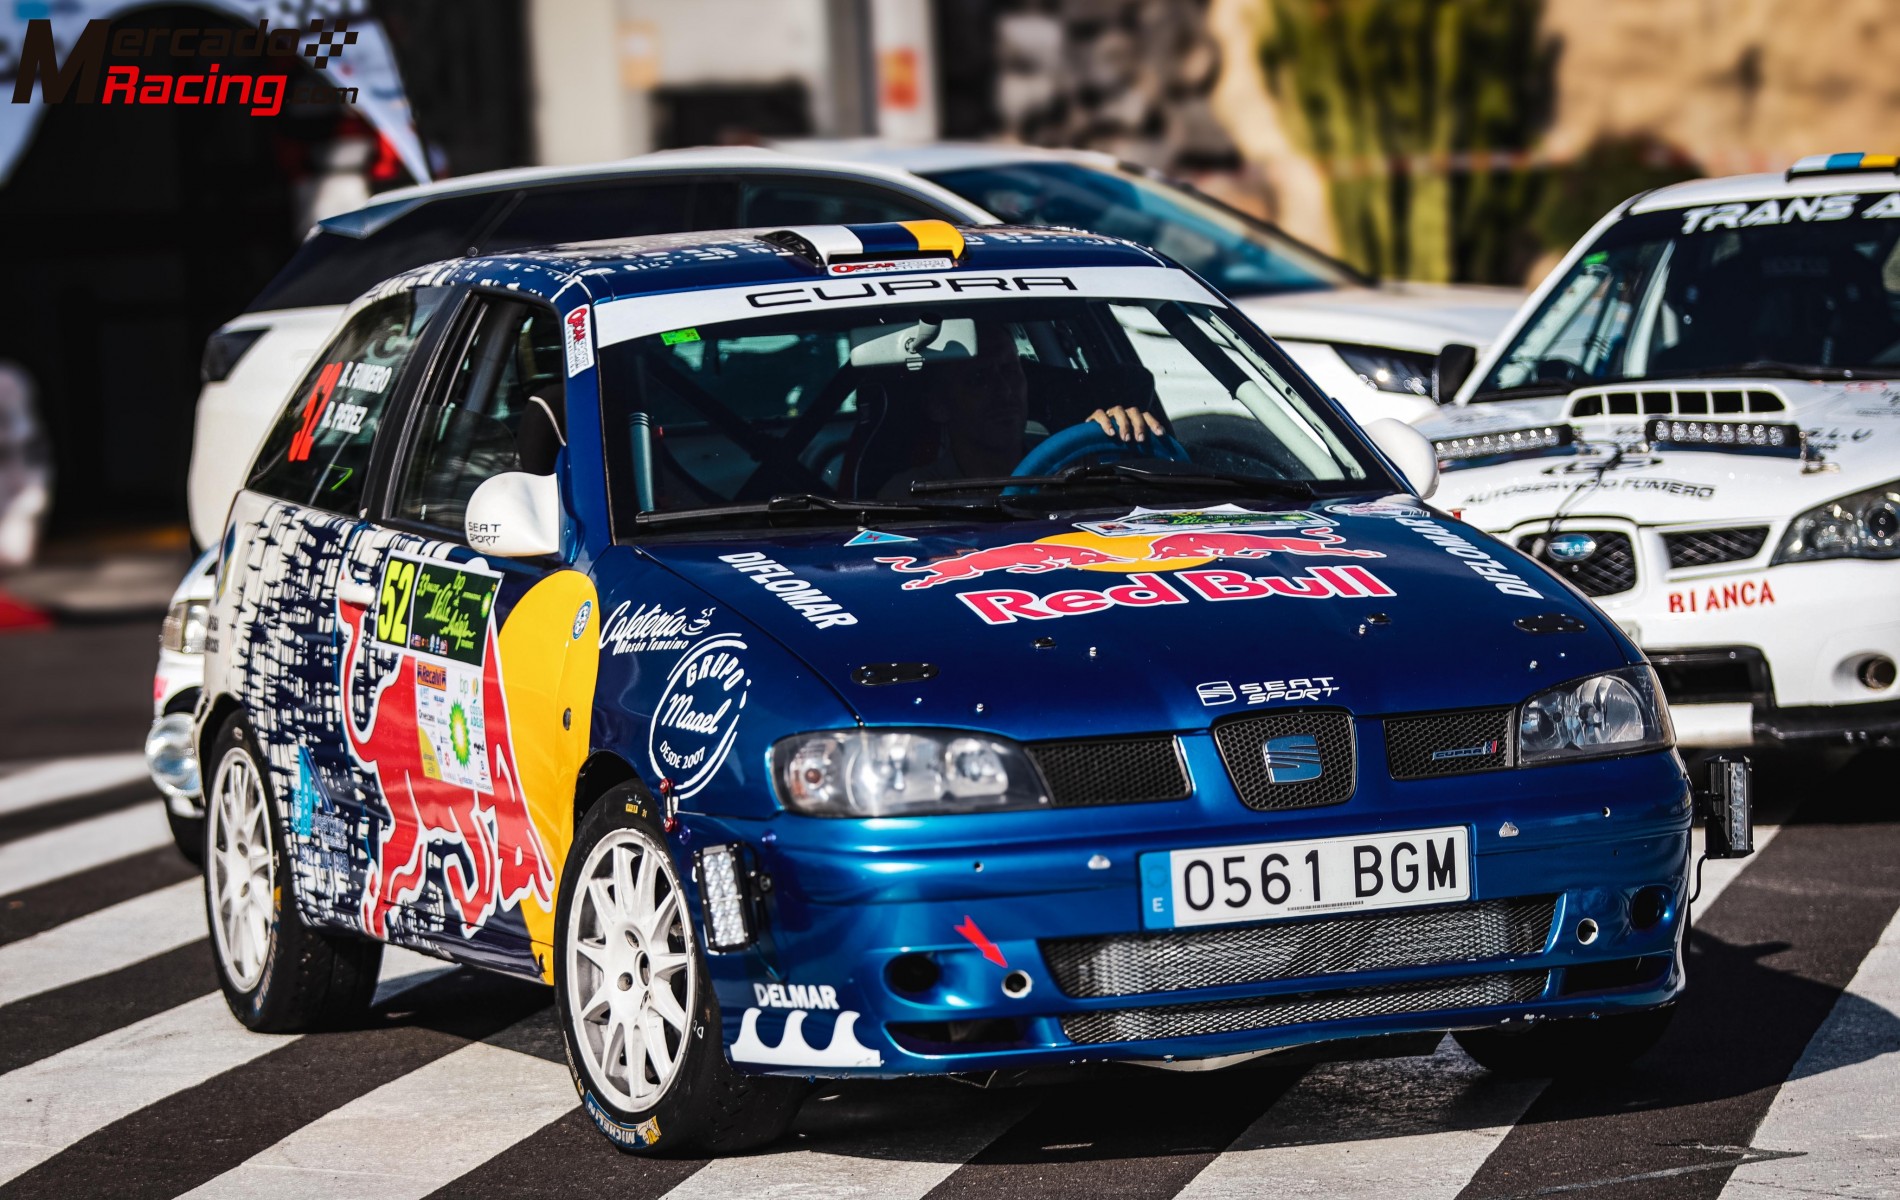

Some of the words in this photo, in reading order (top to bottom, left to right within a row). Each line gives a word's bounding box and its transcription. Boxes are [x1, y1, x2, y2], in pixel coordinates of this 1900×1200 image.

[1681, 193, 1861, 234] TRANS
[746, 277, 1078, 308] CUPRA
[1622, 477, 1717, 500] FUMERO
[468, 521, 501, 533] SEAT
[469, 533, 500, 546] SPORT
[378, 560, 415, 644] 52
[718, 551, 859, 630] DIFLOMAR
[956, 572, 1189, 625] Red
[1174, 565, 1397, 601] Bull
[686, 652, 745, 692] GRUPO
[1239, 676, 1334, 695] SEAT
[1247, 686, 1340, 705] SPORT
[659, 740, 680, 769] DESDE
[682, 746, 706, 769] 2007
[1184, 849, 1322, 911] 0561
[1353, 837, 1457, 898] BGM
[1152, 898, 1164, 912] E
[753, 983, 840, 1010] DELMAR
